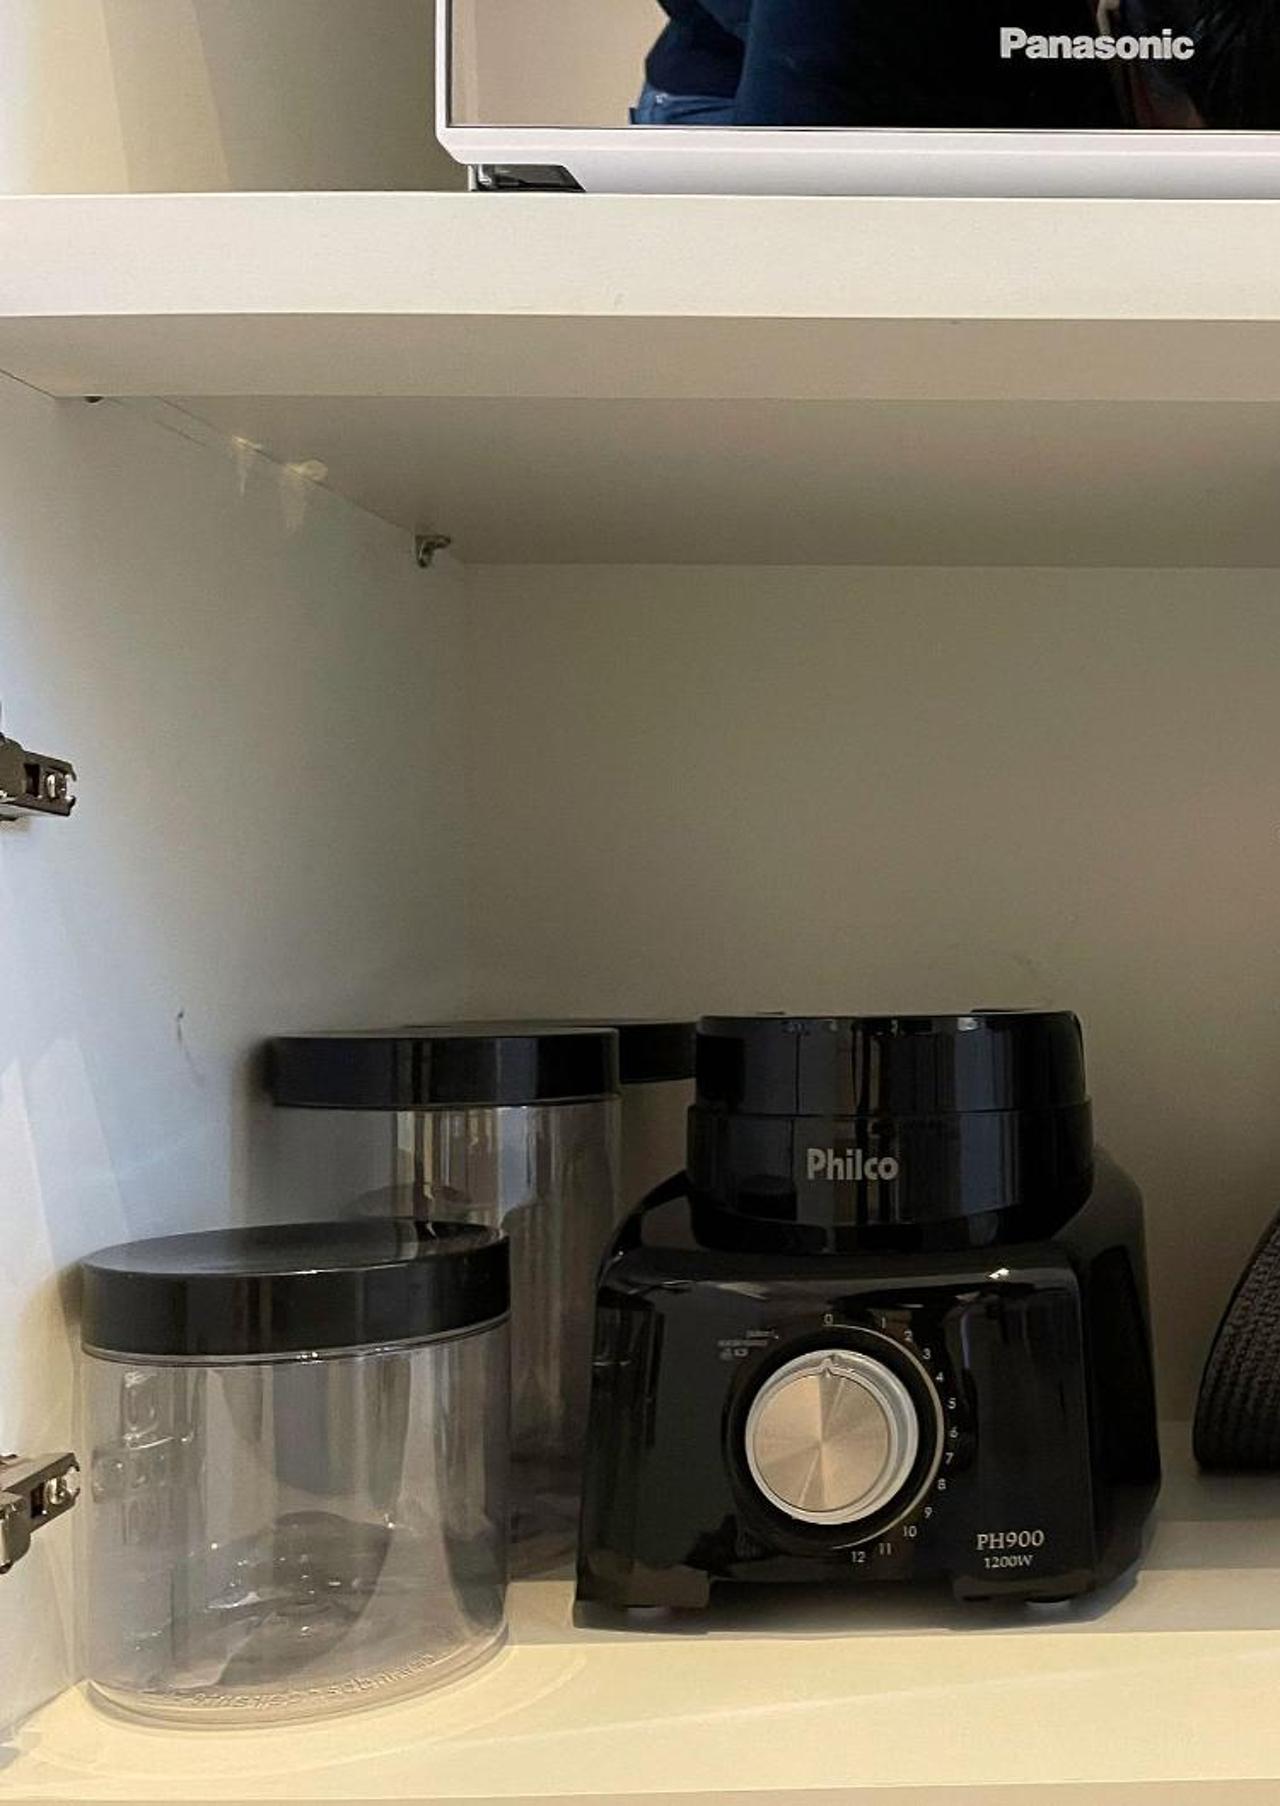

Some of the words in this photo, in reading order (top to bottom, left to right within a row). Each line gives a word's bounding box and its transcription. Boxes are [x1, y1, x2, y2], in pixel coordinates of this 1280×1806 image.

[1000, 26, 1195, 60] Panasonic
[807, 1148, 899, 1180] Philco
[823, 1313, 834, 1325] 0
[881, 1316, 887, 1329] 1
[904, 1330, 914, 1343] 2
[922, 1348, 932, 1360] 3
[936, 1371, 945, 1383] 4
[947, 1397, 957, 1410] 5
[950, 1426, 959, 1439] 6
[945, 1452, 954, 1465] 7
[937, 1477, 947, 1491] 8
[924, 1506, 933, 1519] 9
[902, 1525, 919, 1538] 10
[976, 1529, 1045, 1551] PH900
[878, 1541, 893, 1556] 11
[851, 1550, 866, 1564] 12
[984, 1554, 1034, 1570] 1200W
